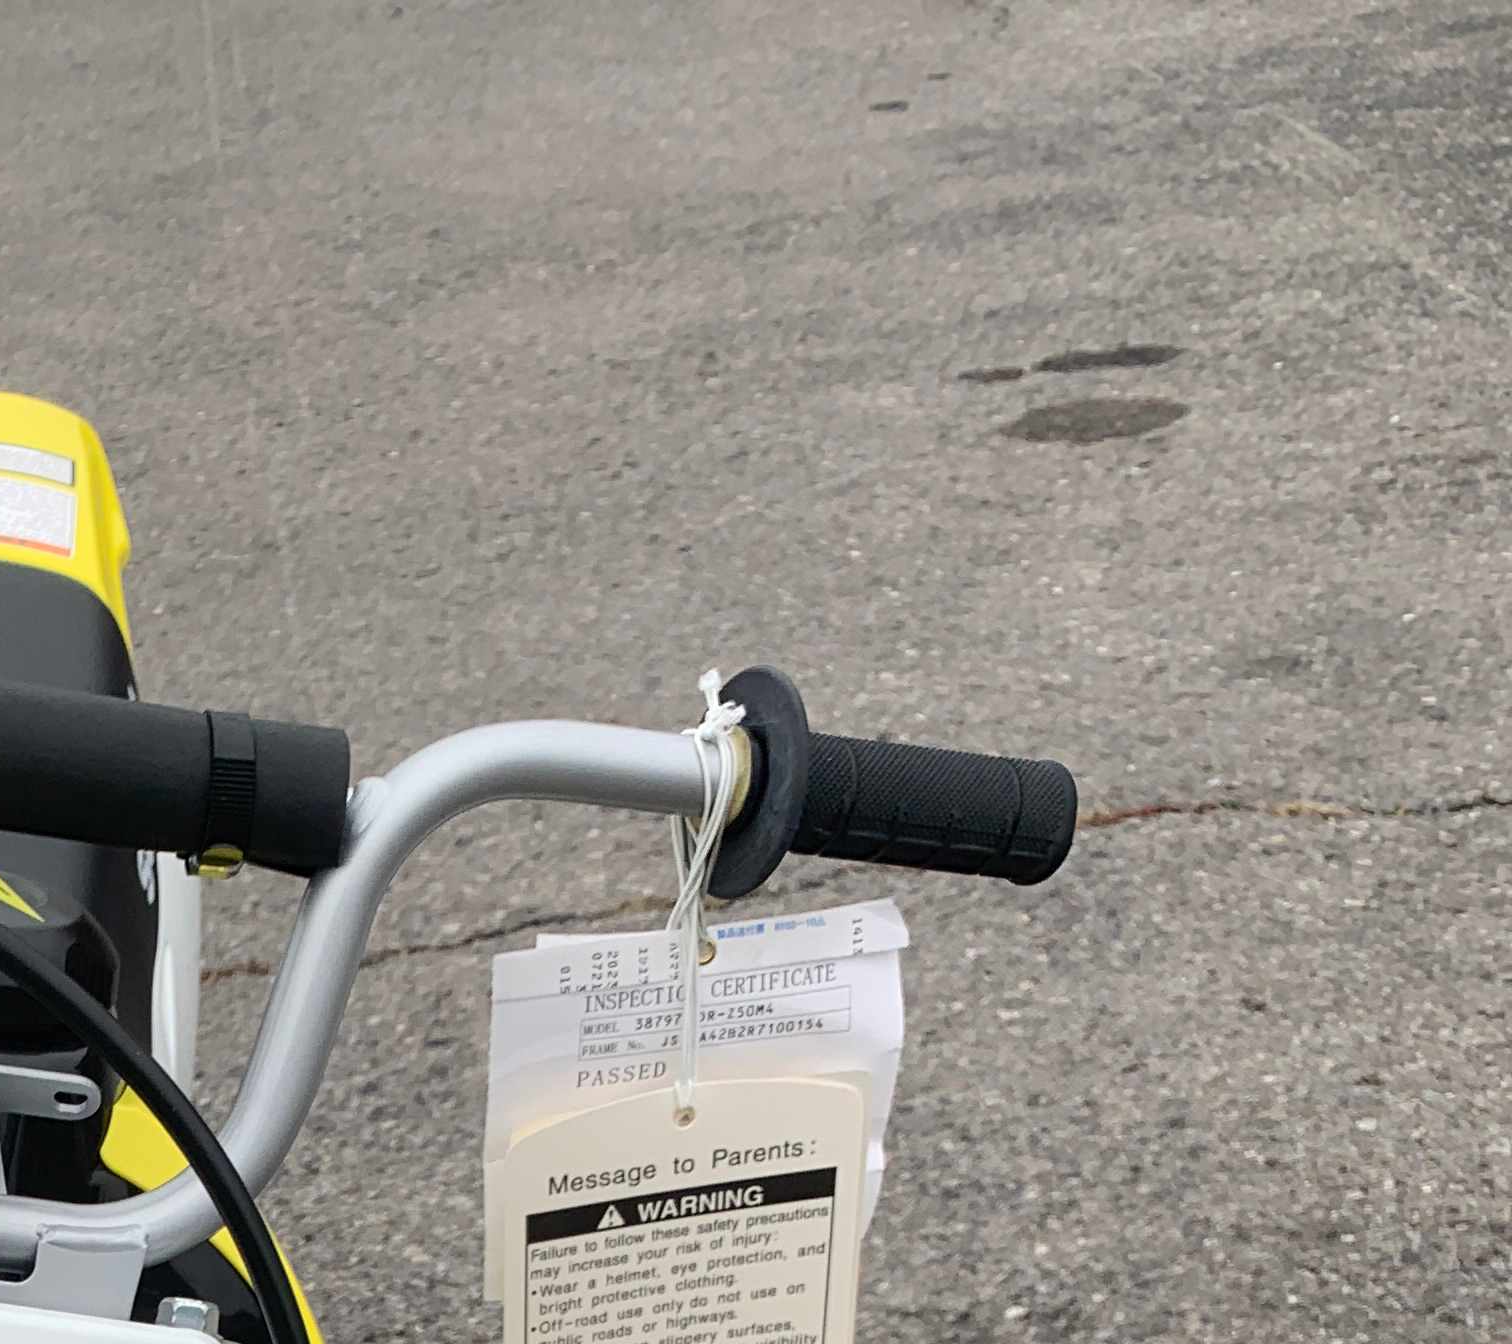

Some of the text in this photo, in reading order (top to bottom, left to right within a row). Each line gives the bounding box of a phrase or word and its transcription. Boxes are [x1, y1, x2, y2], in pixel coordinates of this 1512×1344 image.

[584, 963, 837, 1014] INSPECTIO CERTIFICATE
[583, 1022, 620, 1035] MODEL
[635, 1013, 683, 1031] 38797
[582, 1041, 619, 1057] FRAME
[627, 1040, 646, 1051] No.
[576, 1061, 667, 1088] PASSED
[549, 1165, 656, 1195] Message
[674, 1158, 695, 1174] to
[638, 1186, 763, 1222] WARNING
[531, 1207, 828, 1262] Failure to follow these safety precautions
[530, 1267, 560, 1279] may
[568, 1254, 628, 1273] increase
[637, 1247, 669, 1265] your
[676, 1241, 701, 1255] risk
[710, 1237, 723, 1250] of
[540, 1282, 578, 1297] Wear
[588, 1279, 596, 1289] a
[671, 1263, 697, 1277] eye
[798, 1243, 825, 1257] and
[539, 1283, 805, 1334] Off-road use only do not use on
[540, 1298, 582, 1315] bright
[592, 1285, 665, 1309] protective
[592, 1326, 632, 1341] roads
[642, 1322, 658, 1333] or
